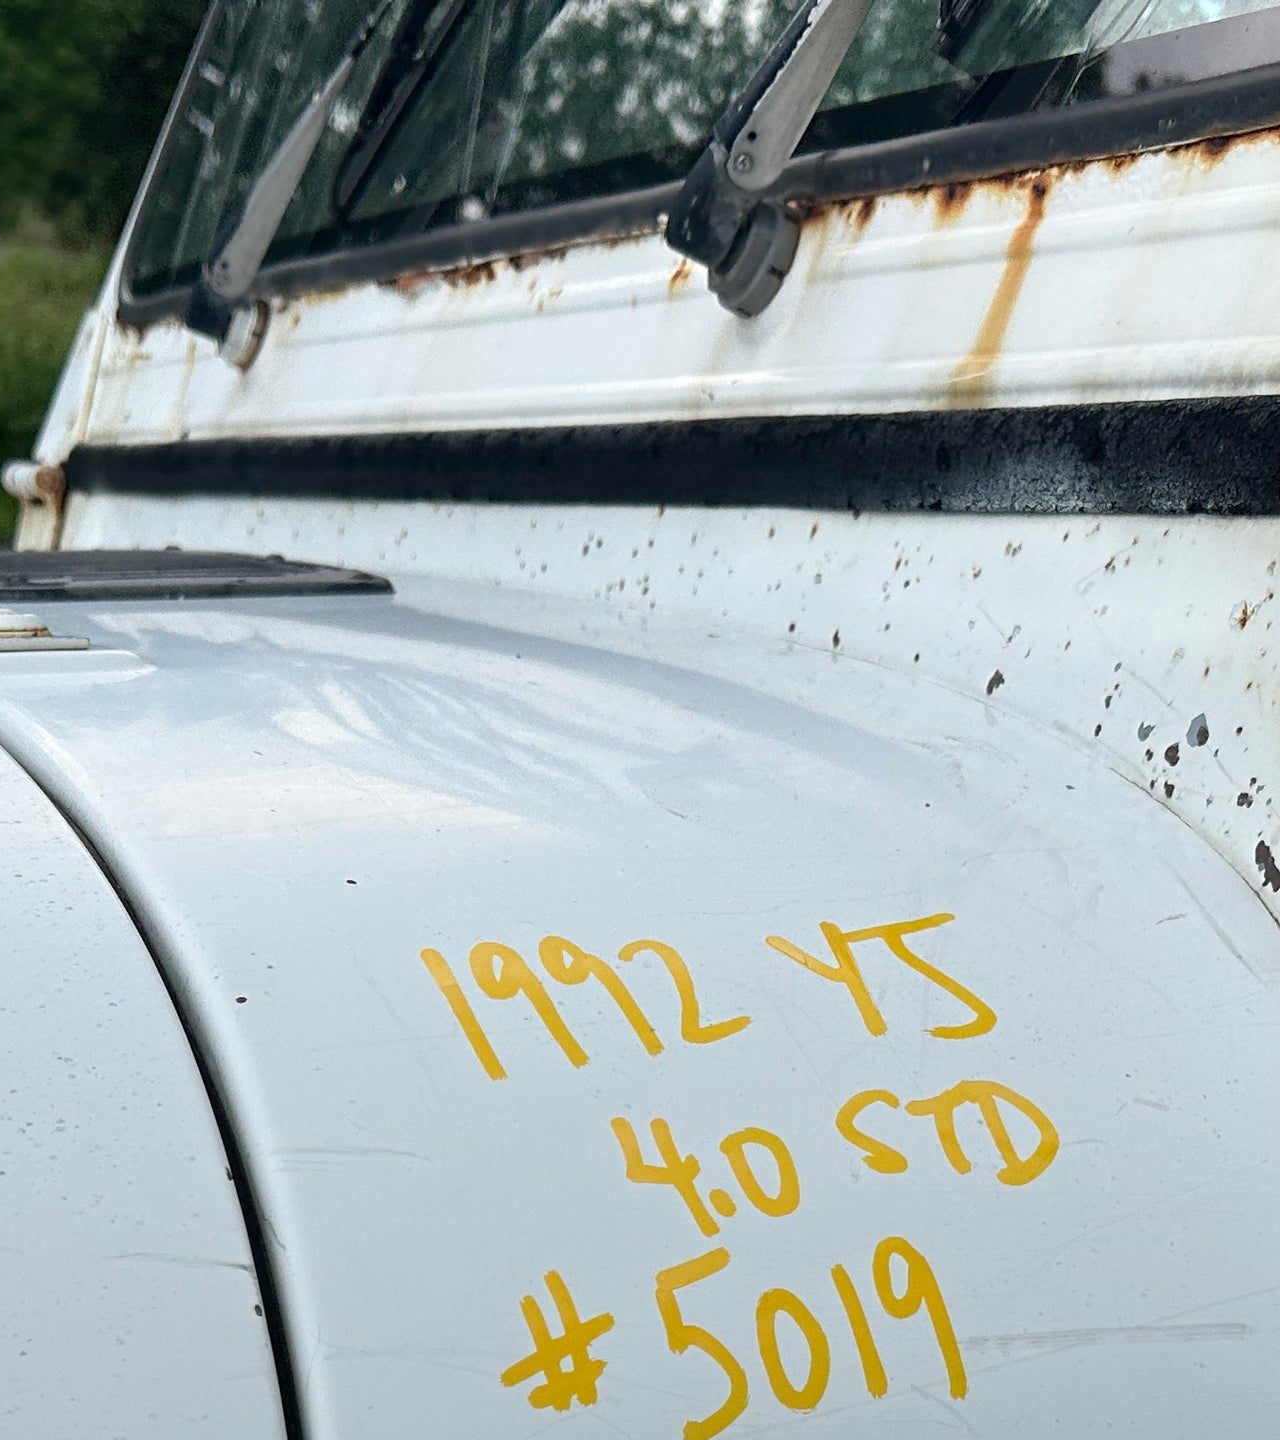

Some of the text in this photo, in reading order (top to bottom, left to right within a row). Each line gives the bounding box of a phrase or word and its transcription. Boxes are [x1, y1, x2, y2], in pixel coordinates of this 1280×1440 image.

[420, 913, 997, 1080] 1992 YJ
[611, 1080, 1060, 1237] 4.0 STD
